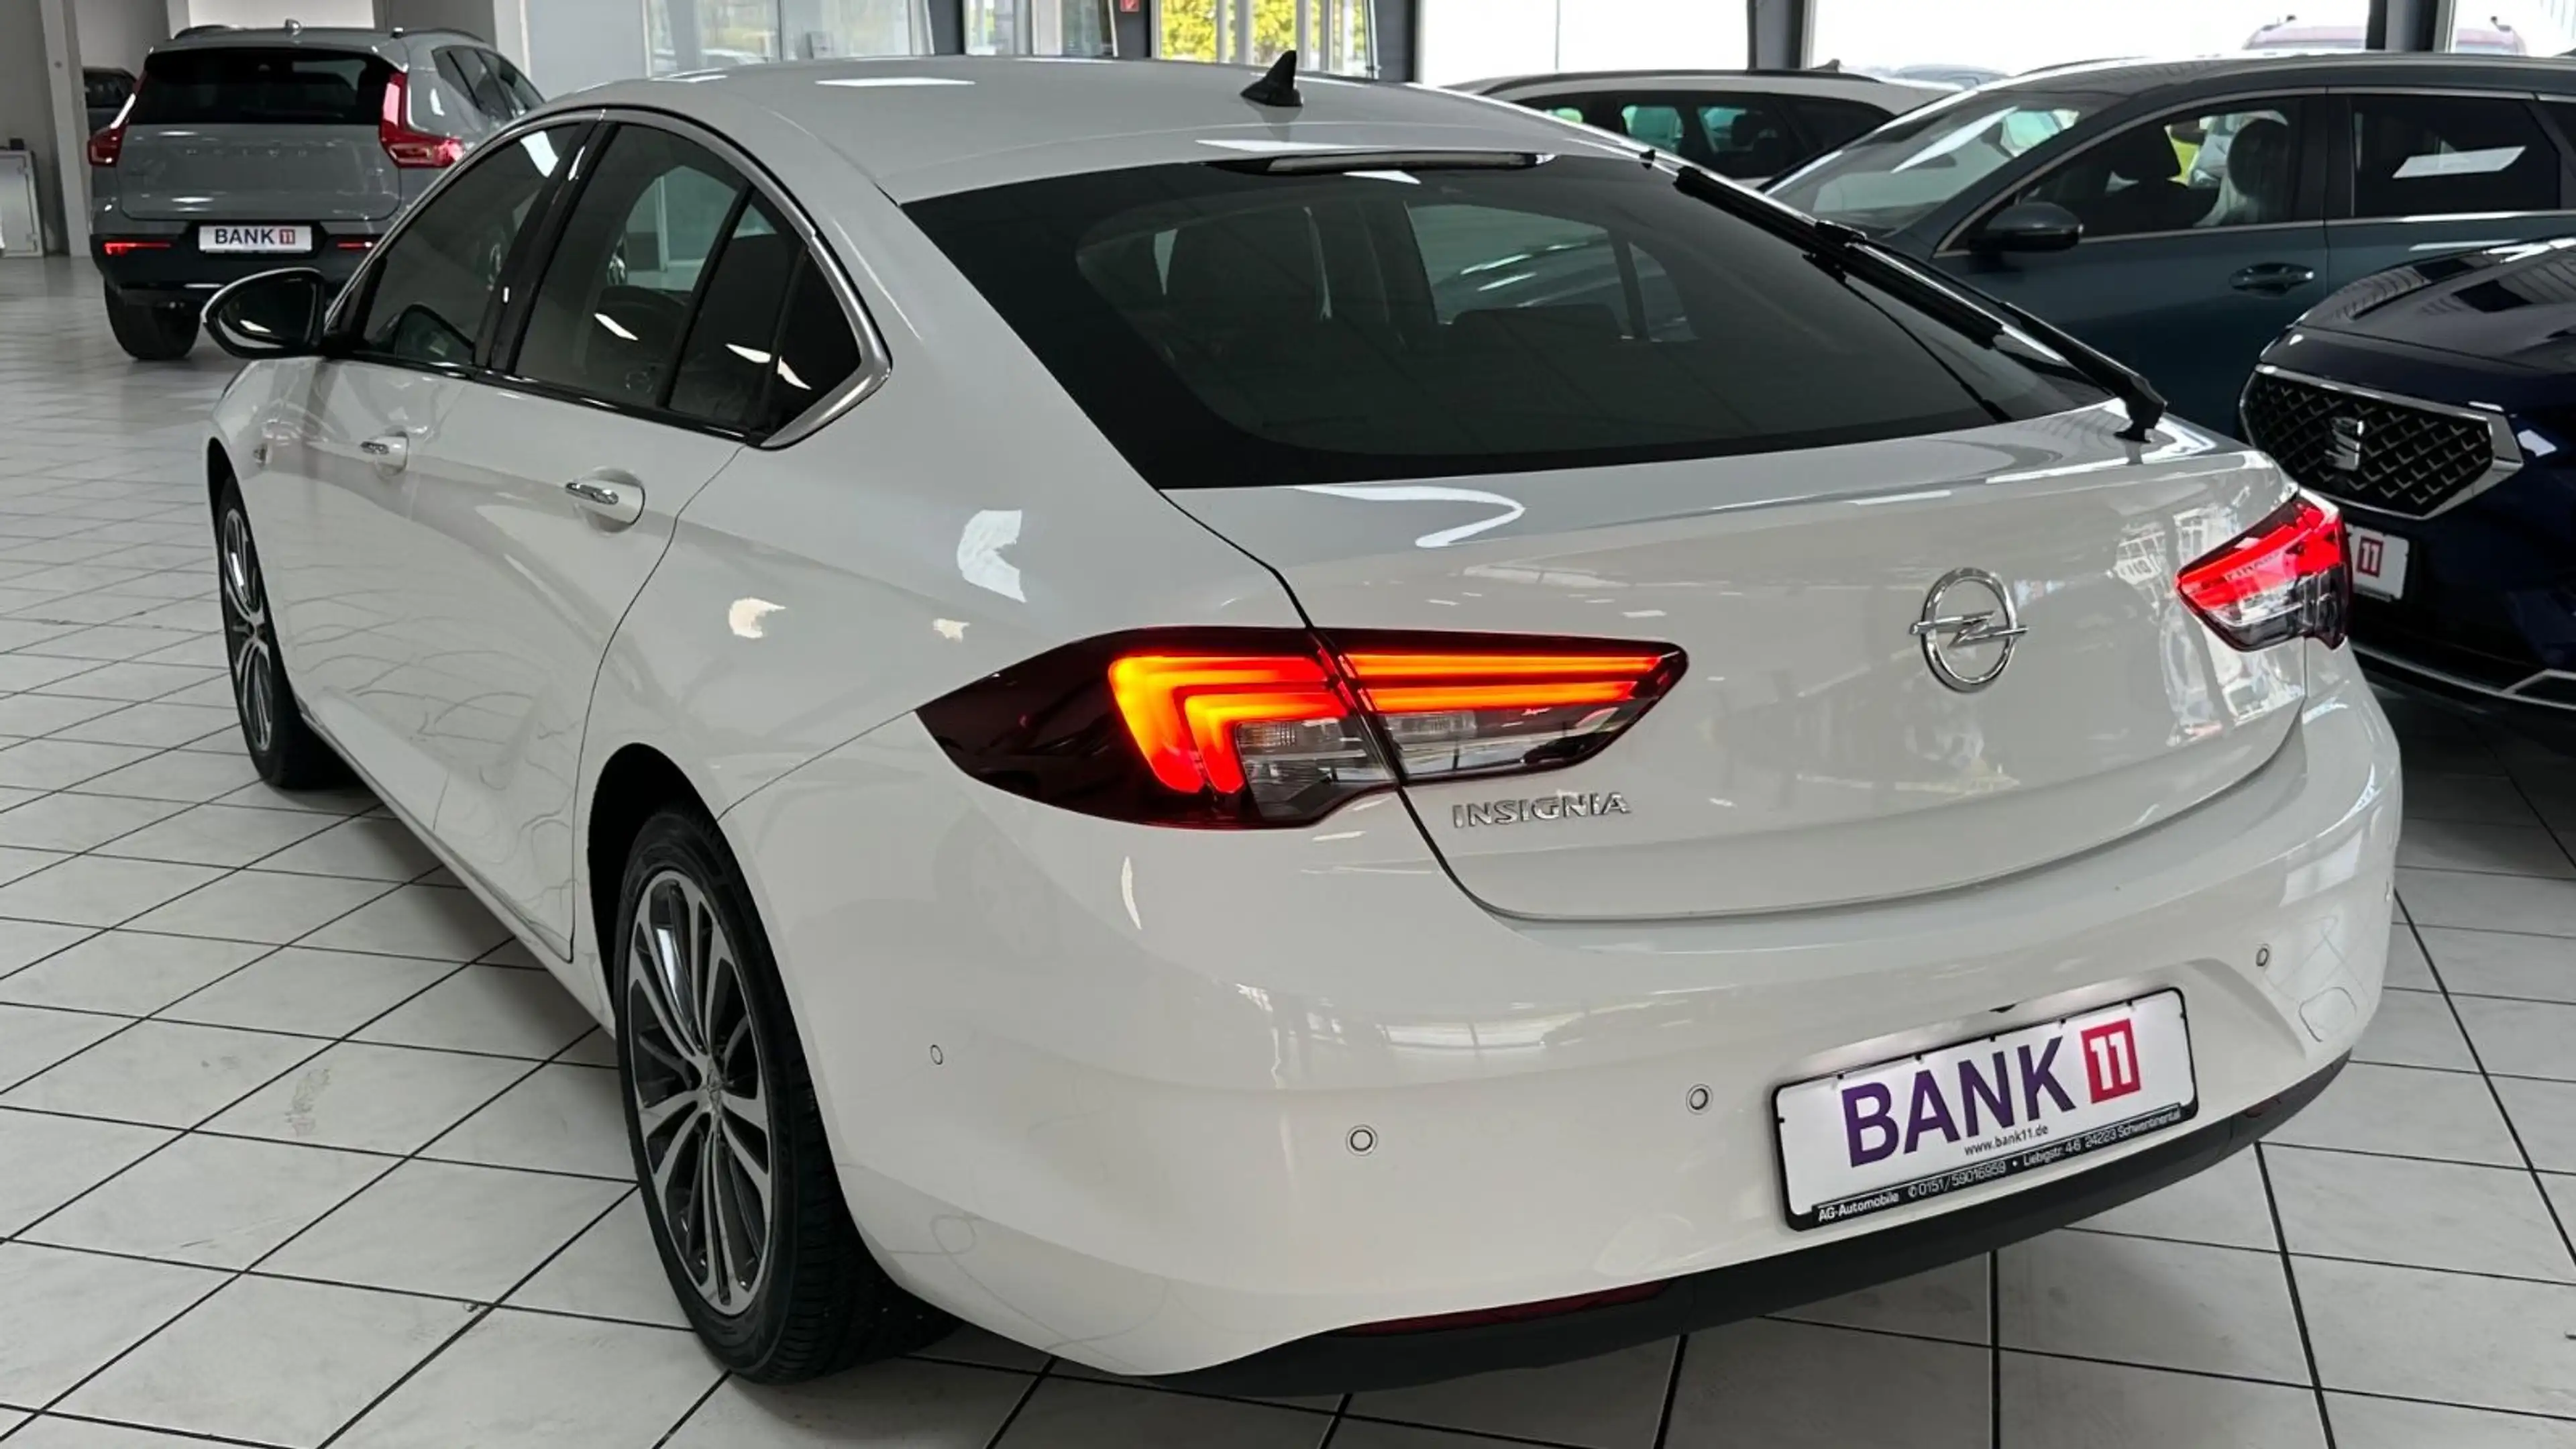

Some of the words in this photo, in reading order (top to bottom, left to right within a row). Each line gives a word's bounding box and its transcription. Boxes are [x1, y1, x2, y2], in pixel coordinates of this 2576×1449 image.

[215, 229, 274, 244] BANK
[2361, 541, 2381, 574] 11
[1452, 792, 1632, 828] INSIGNIA
[1841, 1036, 2077, 1168] BANK
[2088, 1029, 2133, 1092] 11
[1964, 1124, 2048, 1155] www.bank11.de
[1818, 1191, 1900, 1222] AG-Automobile
